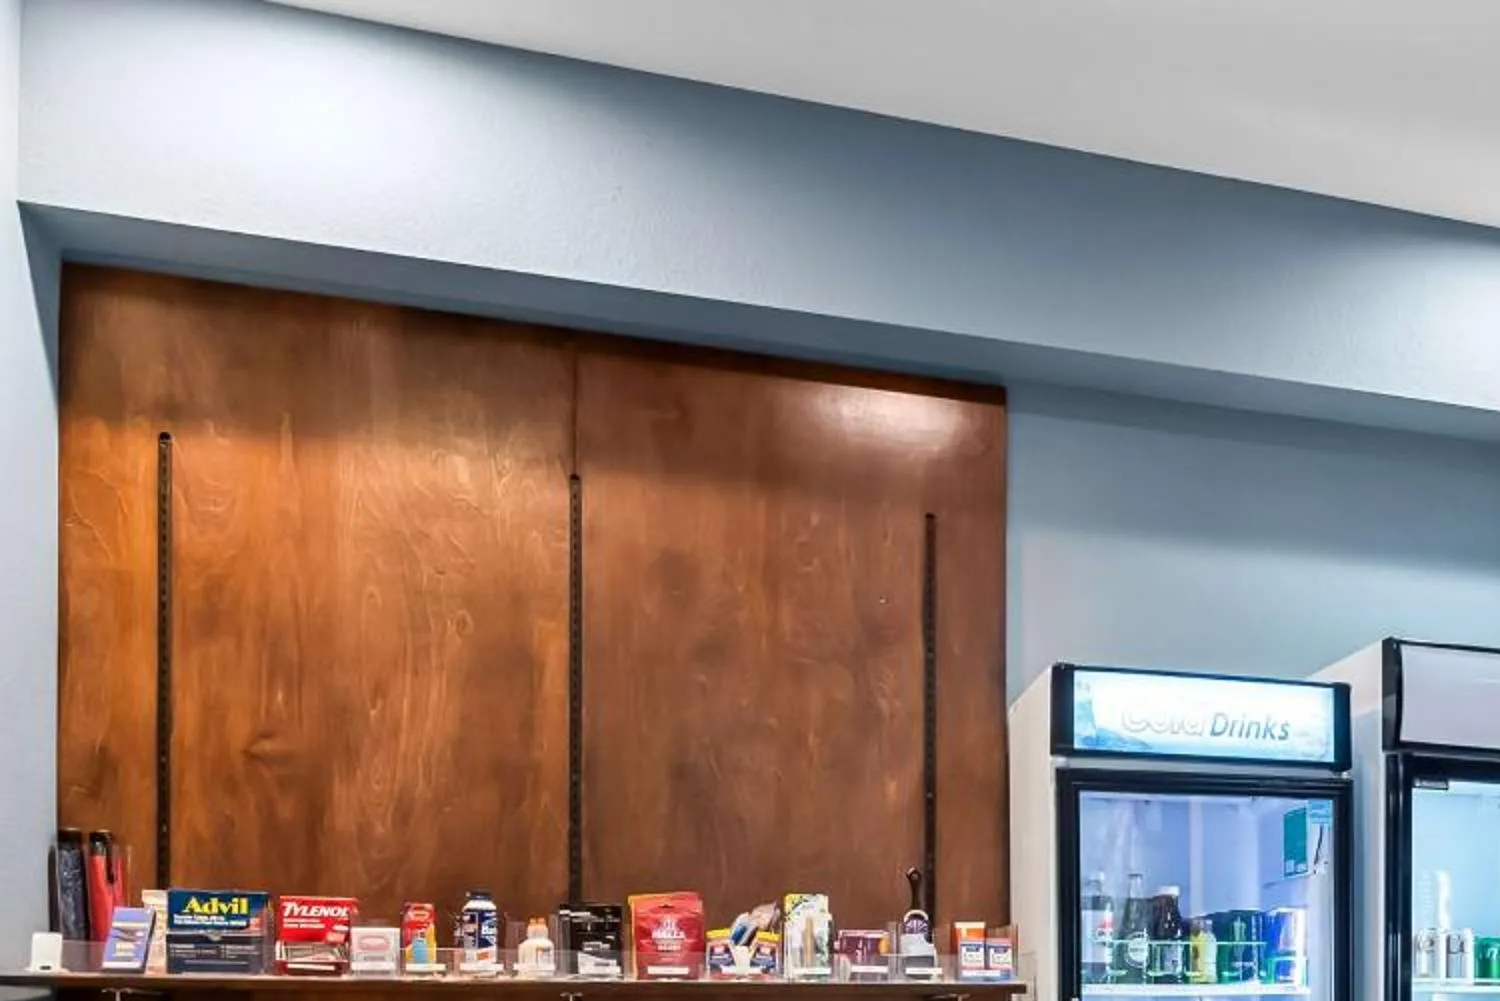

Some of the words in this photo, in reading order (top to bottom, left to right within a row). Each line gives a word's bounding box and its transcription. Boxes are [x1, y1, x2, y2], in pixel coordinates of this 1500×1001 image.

[1209, 712, 1292, 741] Drinks
[182, 896, 249, 915] Advil
[282, 902, 348, 917] TYLENOL
